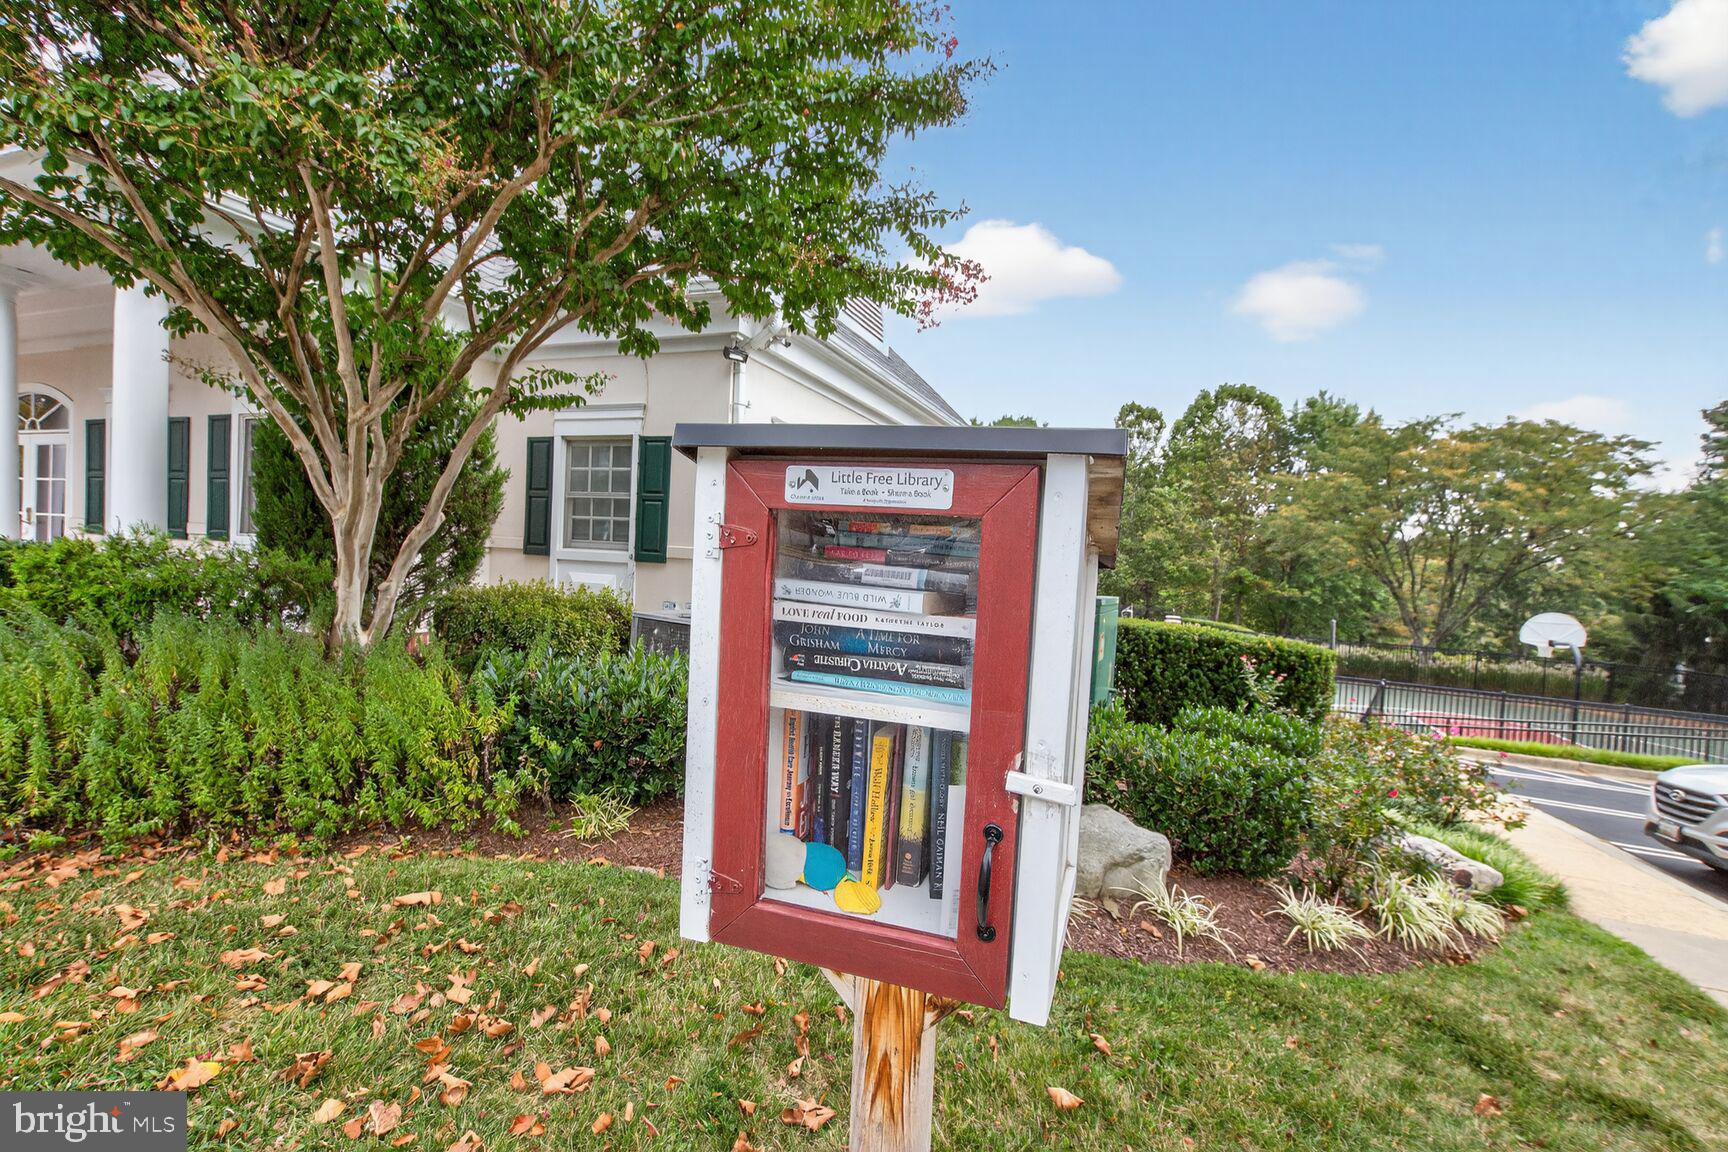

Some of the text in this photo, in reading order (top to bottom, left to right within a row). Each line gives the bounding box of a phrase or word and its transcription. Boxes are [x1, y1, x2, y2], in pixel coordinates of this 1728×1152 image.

[831, 471, 943, 491] Little Free Library
[840, 488, 856, 496] Take
[861, 488, 878, 496] Book
[913, 490, 932, 498] Book
[795, 586, 887, 604] WILD BLUE WONDER
[782, 607, 868, 623] LOVE real FOOD
[801, 622, 830, 635] JOHN
[917, 620, 945, 628] TAYLOR
[789, 633, 841, 651] GRISHAM
[855, 628, 920, 645] A TIME FOR
[867, 641, 907, 657] MERCY
[814, 655, 861, 672] CHRISTIE
[863, 659, 908, 676] AGATHA
[830, 771, 840, 793] WAY
[869, 789, 881, 824] Hollow
[936, 812, 945, 836] NEIL
[935, 838, 944, 879] GAIMAN
